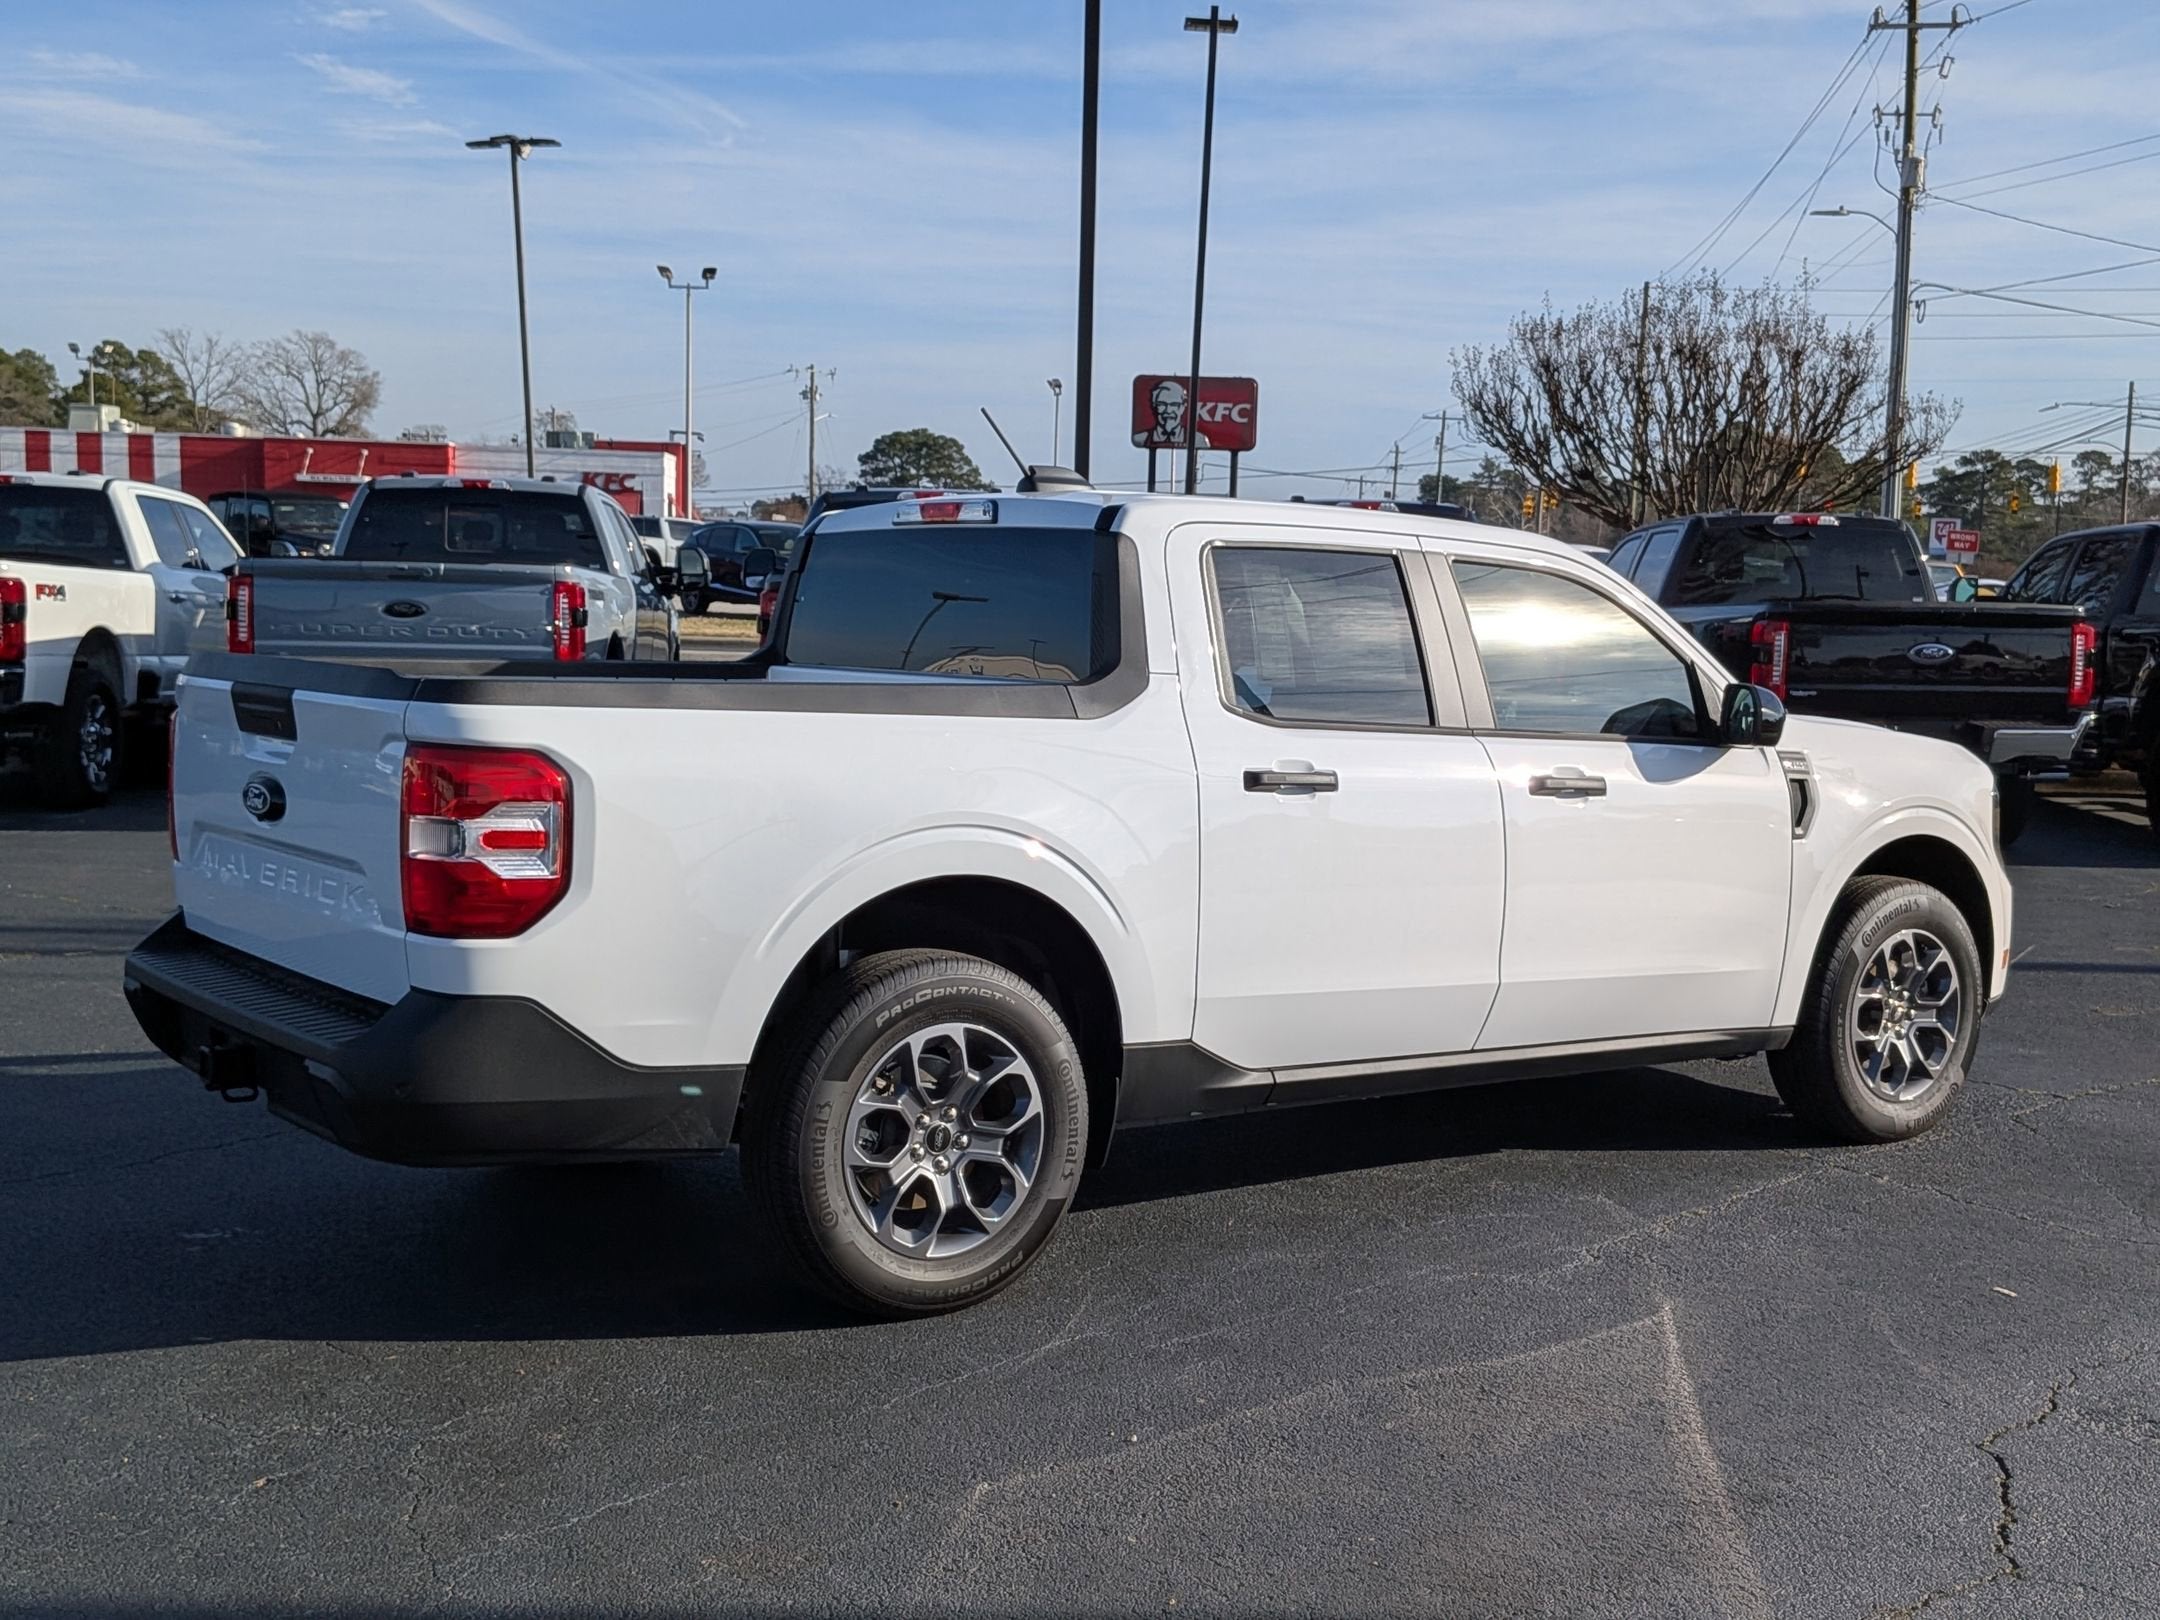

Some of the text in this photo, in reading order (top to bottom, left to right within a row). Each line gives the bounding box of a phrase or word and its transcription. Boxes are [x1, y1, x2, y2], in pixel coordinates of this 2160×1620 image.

[1196, 402, 1250, 424] KFC
[582, 472, 636, 492] KFC
[1950, 532, 1977, 542] WRONG
[1954, 541, 1971, 549] WAY
[35, 583, 66, 600] FX4
[426, 624, 538, 640] DUTY
[1861, 899, 1912, 948] Continental
[1056, 1058, 1080, 1164] Continental
